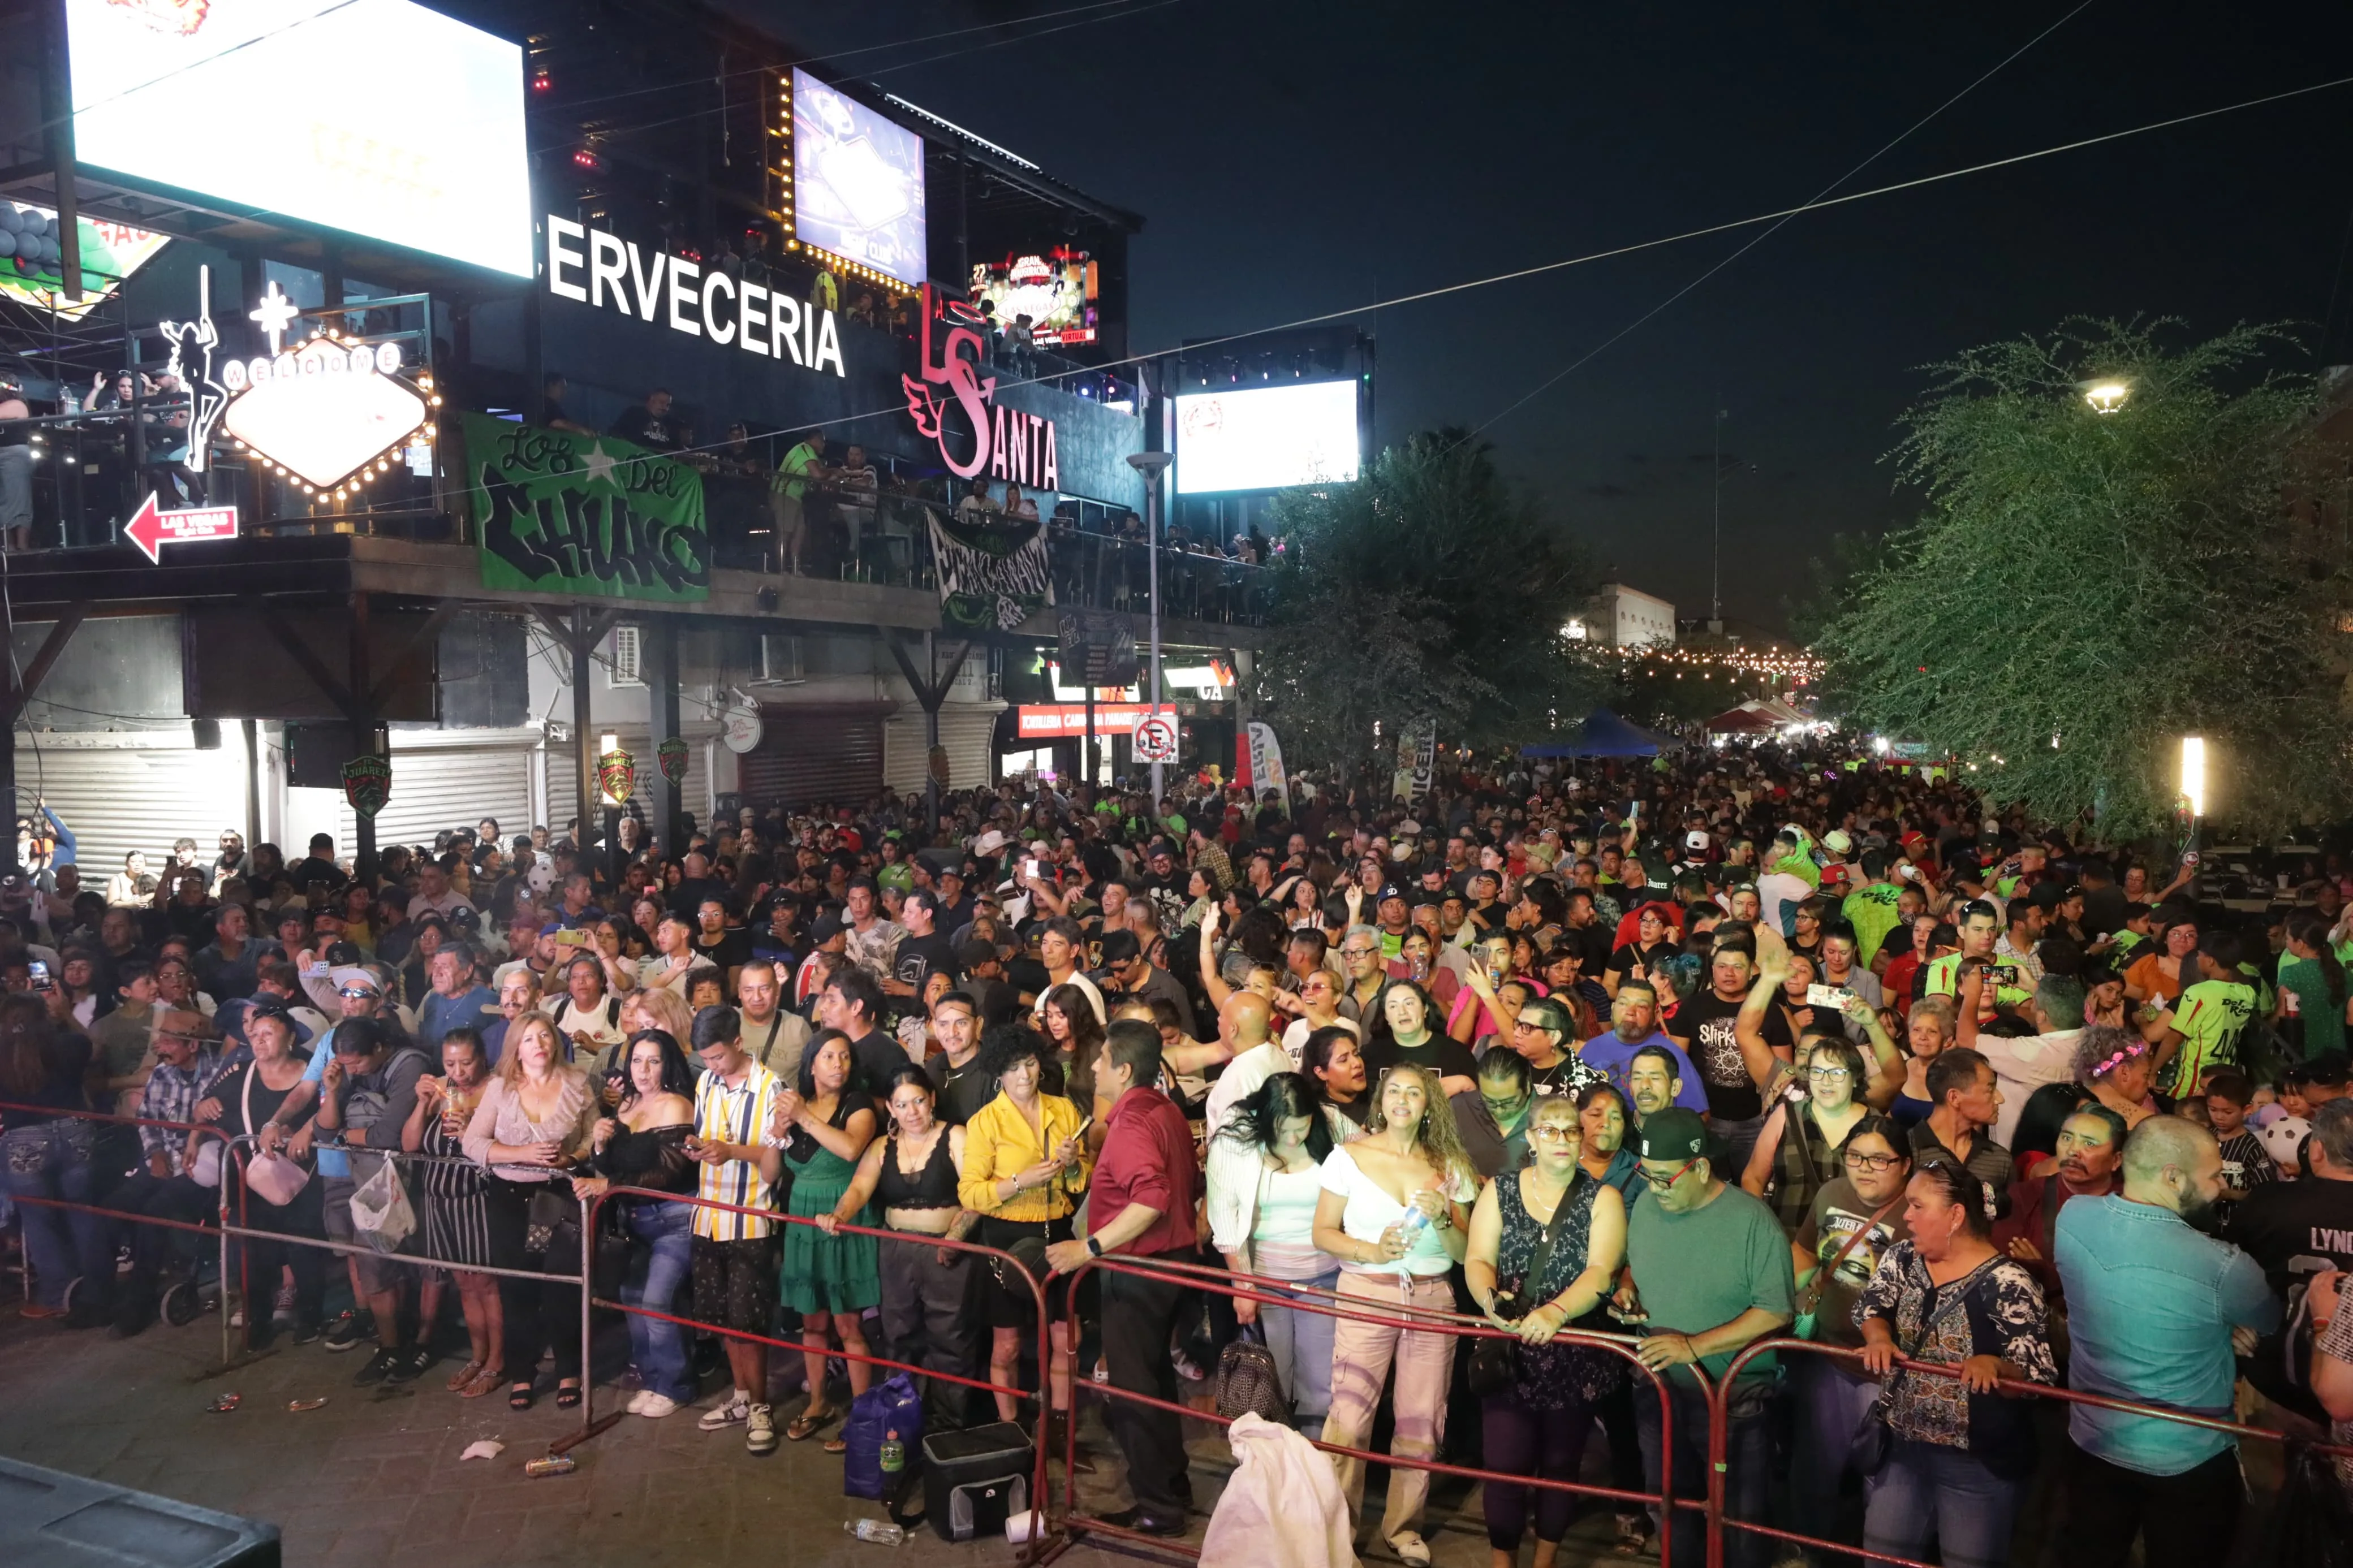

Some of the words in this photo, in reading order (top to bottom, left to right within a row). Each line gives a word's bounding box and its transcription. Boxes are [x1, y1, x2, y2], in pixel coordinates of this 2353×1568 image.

[537, 214, 846, 378] ERVECERIA
[1005, 306, 1022, 316] LAS
[1025, 302, 1054, 314] VEGAS
[1062, 332, 1085, 342] VIRTUAL
[226, 349, 396, 386] WELCOME
[161, 516, 186, 529] LAS
[186, 513, 229, 528] VEGAS
[1699, 1023, 1738, 1048] Slipk
